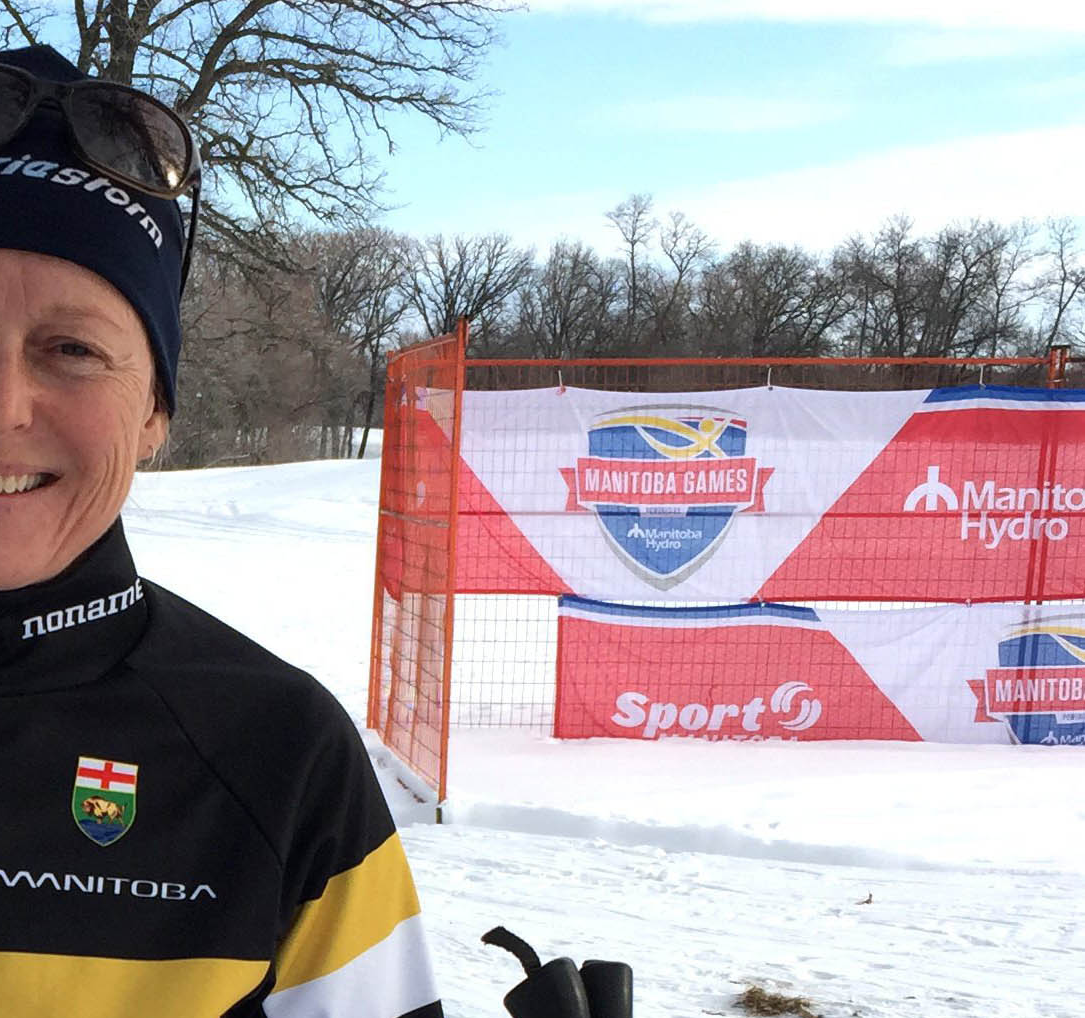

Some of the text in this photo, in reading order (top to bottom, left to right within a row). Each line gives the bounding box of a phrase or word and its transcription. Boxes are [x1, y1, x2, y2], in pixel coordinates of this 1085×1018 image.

[585, 468, 747, 495] MANITOBA GAMES
[962, 480, 1085, 511] Manito
[645, 528, 702, 540] Manitoba
[960, 511, 1068, 549] Hydro
[646, 539, 681, 552] Hydro
[995, 677, 1085, 702] MANITOB
[611, 691, 766, 738] Sport
